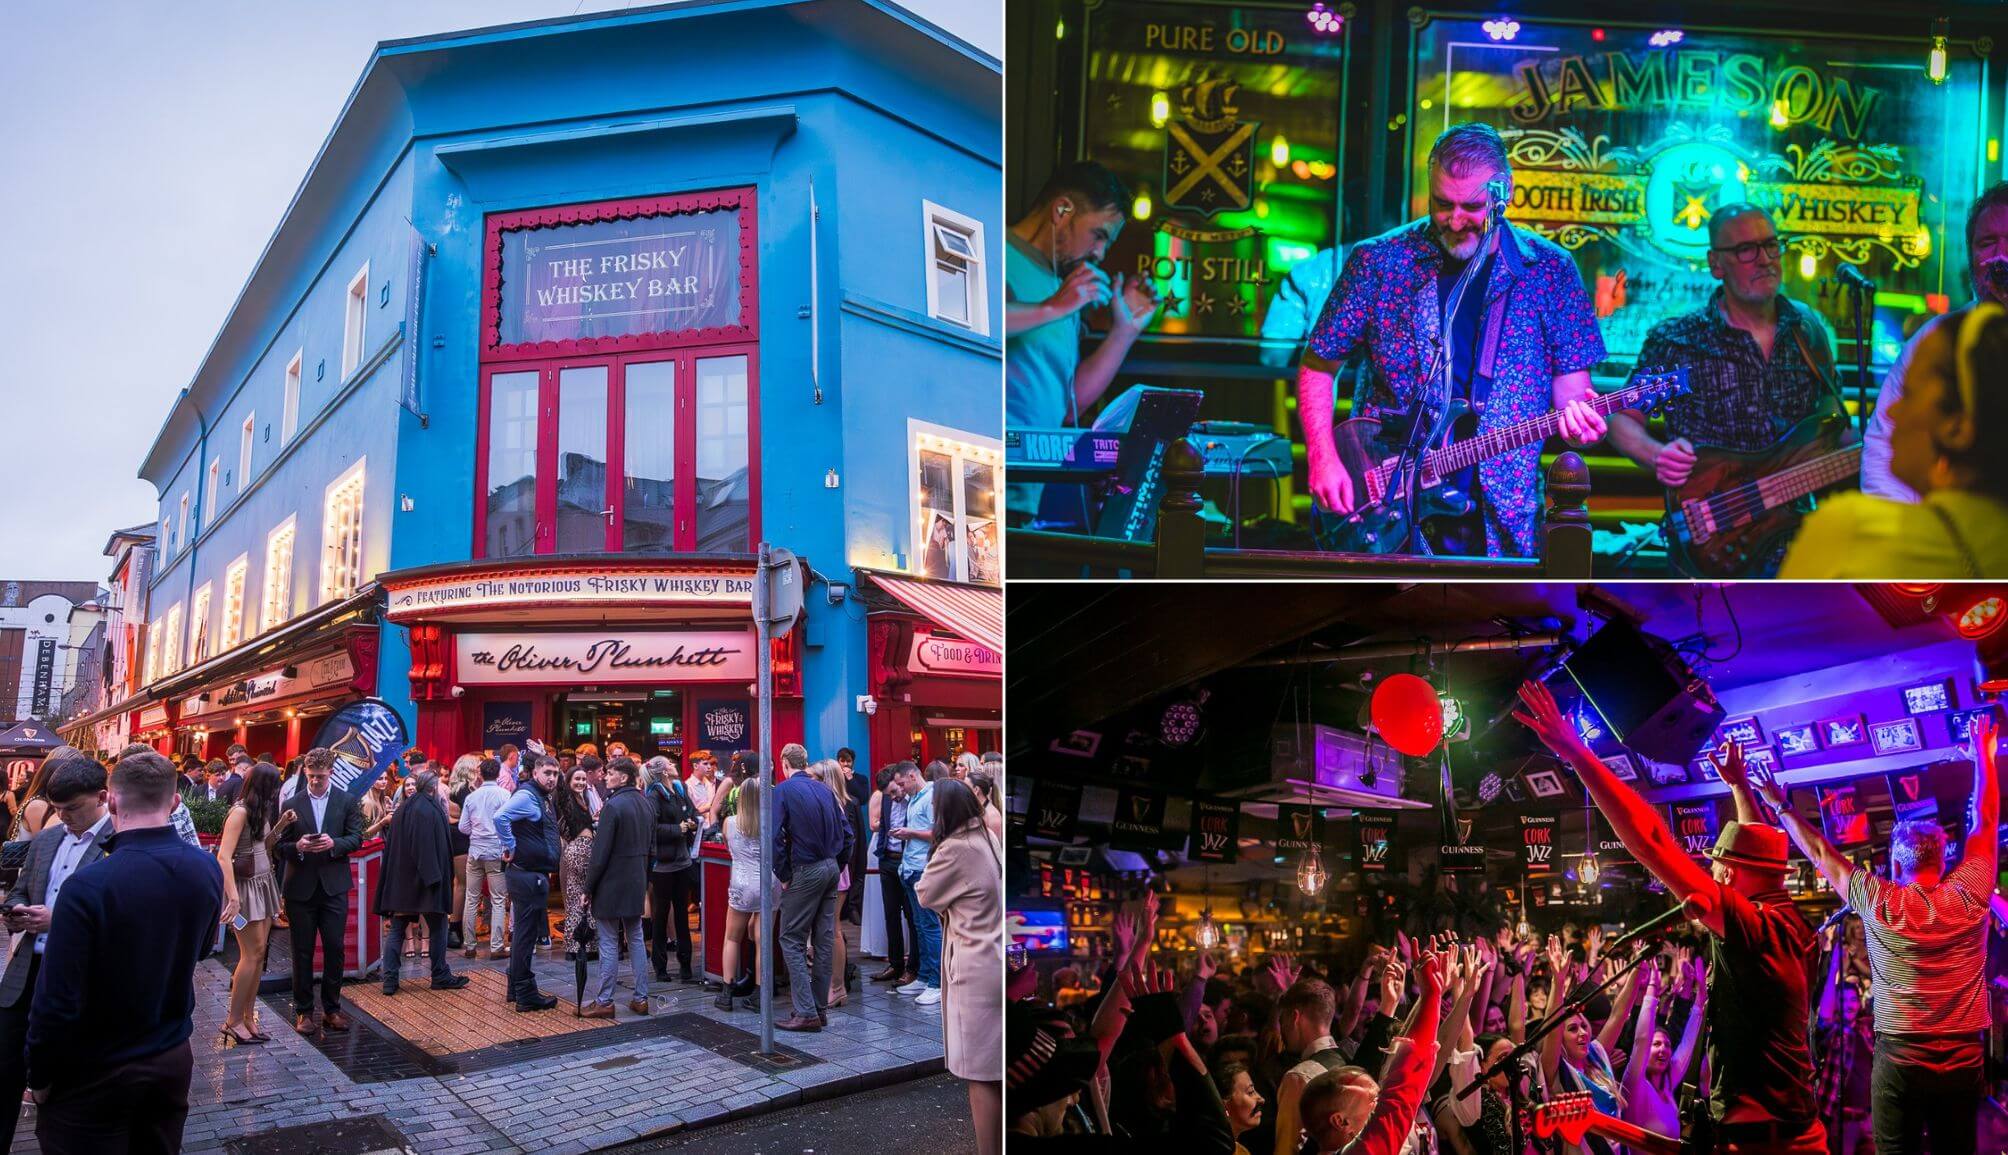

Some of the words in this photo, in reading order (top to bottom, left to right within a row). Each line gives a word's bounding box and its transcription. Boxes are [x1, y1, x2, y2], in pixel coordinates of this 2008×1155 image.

[1145, 24, 1214, 51] PURE
[1227, 28, 1284, 54] OLD
[1511, 48, 1882, 141] JAMESON
[1512, 184, 1574, 212] OOTH
[1580, 183, 1640, 213] IRISH
[1758, 192, 1907, 224] WHISKEY
[549, 257, 593, 280] THE
[600, 245, 688, 275] FRISKY
[1137, 254, 1193, 282] POT
[1202, 257, 1272, 285] STILL
[536, 276, 644, 306] WHISKEY
[648, 275, 700, 298] BAR
[1025, 433, 1076, 462] KORG
[416, 586, 472, 605] FEATURING
[476, 580, 504, 598] THE
[509, 580, 581, 595] NOTORIOUS
[587, 575, 648, 594] FRISKY
[654, 578, 720, 597] WHISKEY
[725, 579, 753, 594] BAR
[471, 650, 496, 665] the
[497, 643, 579, 672] Oliver
[577, 639, 741, 673] Plunkett
[930, 643, 963, 661] FOOD
[964, 648, 974, 663] &
[705, 711, 740, 725] FRISKY
[361, 711, 399, 753] JAZZ
[707, 723, 744, 739] WHISKEY
[1038, 808, 1069, 829] JAZZ
[1115, 821, 1161, 834] GUINNESS
[1200, 815, 1228, 832] CORK
[1365, 815, 1393, 823] GUINNESS
[1681, 817, 1707, 835] CORK
[1200, 832, 1229, 851] JAZZ
[1278, 838, 1322, 850] GUINNSS
[1360, 827, 1388, 843] CORK
[1523, 827, 1551, 844] CORK
[1684, 835, 1710, 854] JAZZ
[1362, 844, 1388, 862] JAZZ
[1441, 844, 1484, 854] GUINNESS
[1525, 844, 1553, 863] JAZZ
